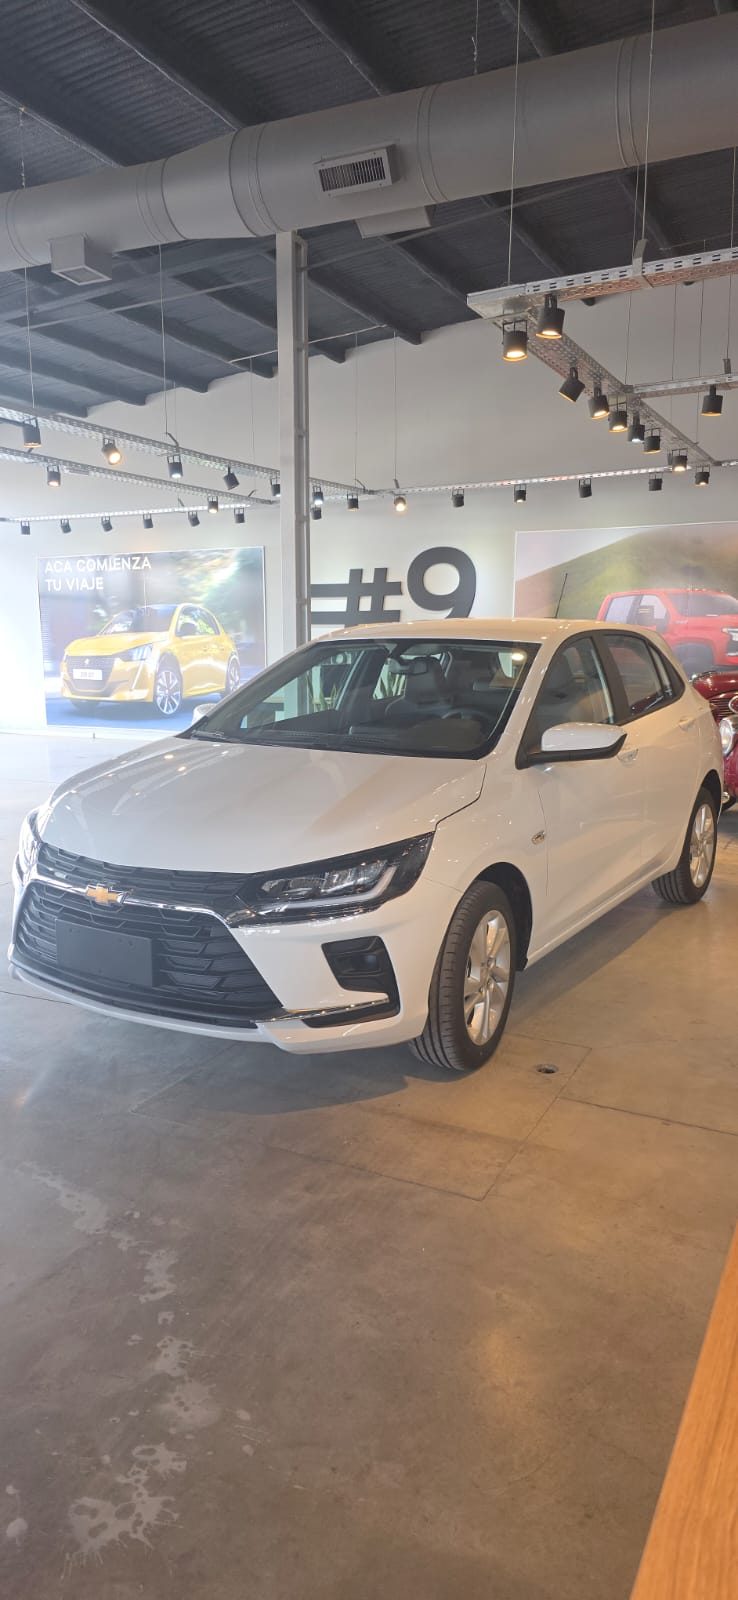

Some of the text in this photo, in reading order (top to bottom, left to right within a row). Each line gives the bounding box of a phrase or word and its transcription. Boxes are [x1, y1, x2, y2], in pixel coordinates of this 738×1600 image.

[45, 557, 151, 573] ACA COMIENZA
[45, 577, 104, 592] TU VIAJE
